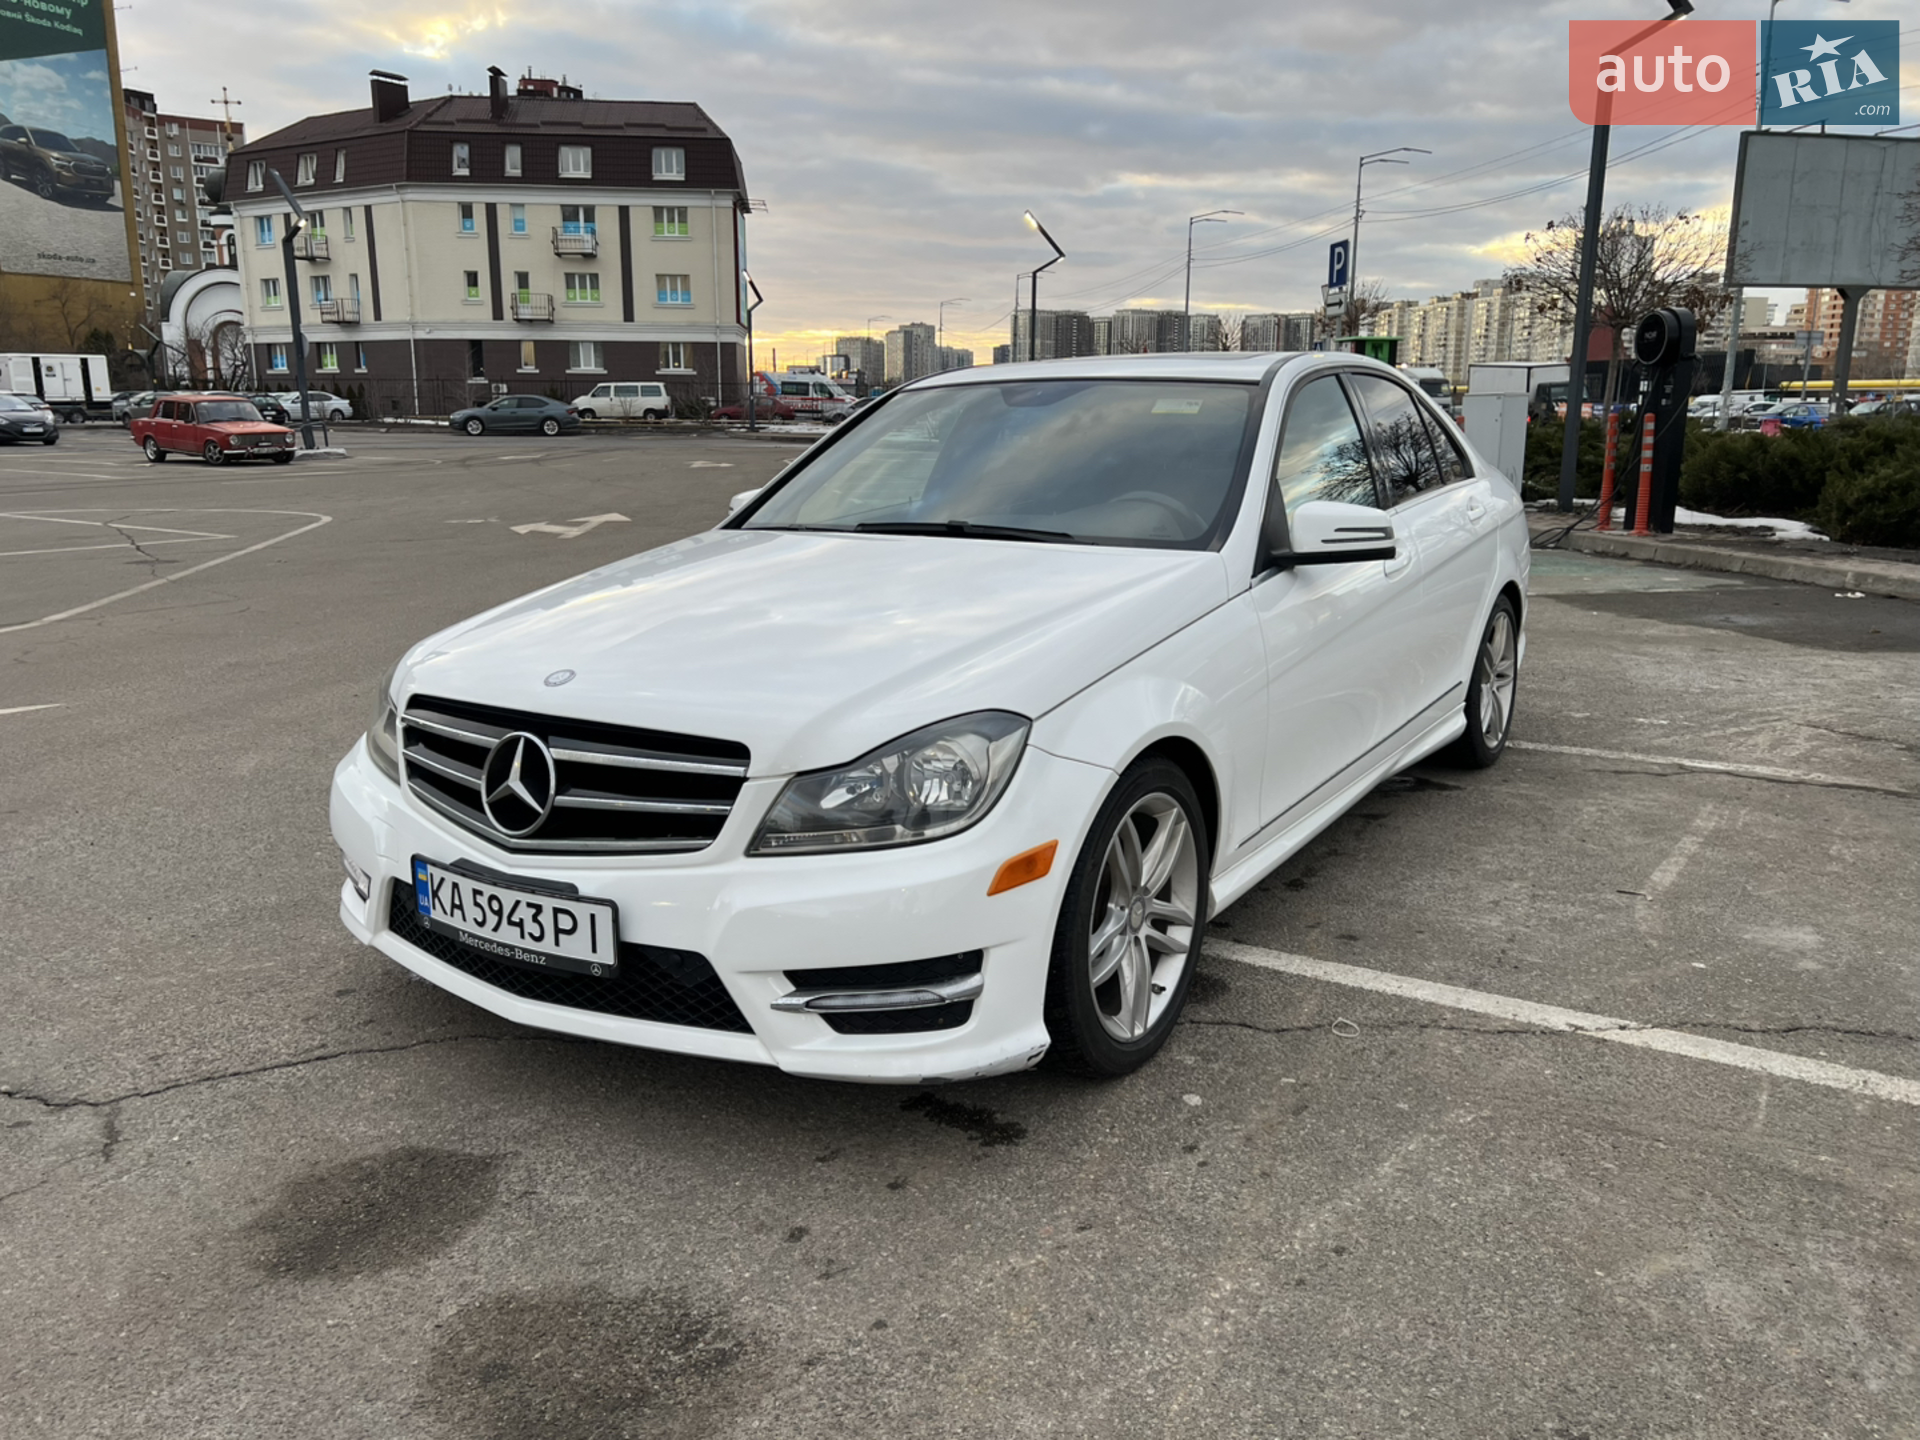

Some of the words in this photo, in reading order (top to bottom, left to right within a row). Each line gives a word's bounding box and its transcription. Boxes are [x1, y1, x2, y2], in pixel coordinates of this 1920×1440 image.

[0, 9, 23, 20] овий
[25, 11, 52, 28] Škoda
[53, 20, 84, 37] Kodiaq
[1332, 246, 1345, 284] P
[418, 894, 430, 907] UA
[459, 931, 547, 965] Mercedes-Benz
